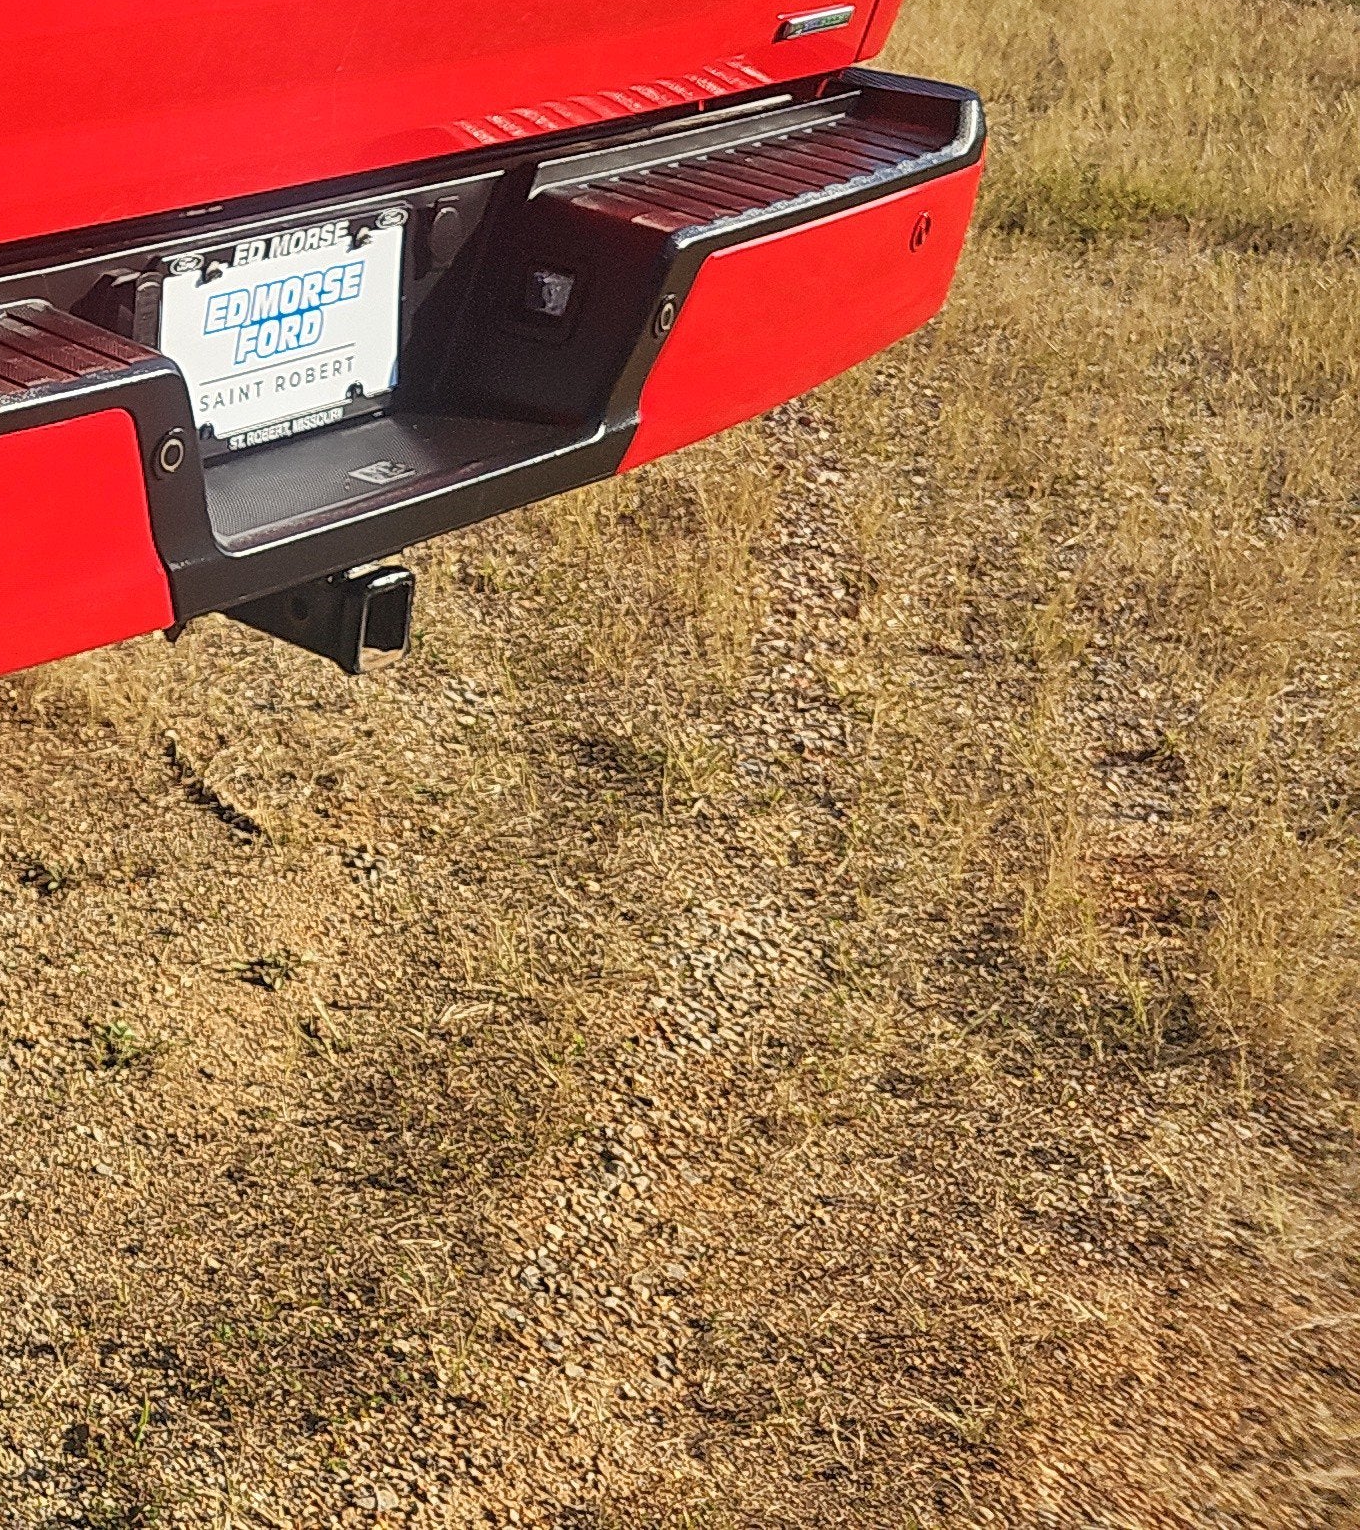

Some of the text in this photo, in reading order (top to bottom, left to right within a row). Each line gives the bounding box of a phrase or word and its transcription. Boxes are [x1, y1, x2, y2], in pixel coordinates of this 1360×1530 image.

[233, 242, 268, 269] ED
[269, 219, 351, 258] MORSE
[203, 260, 365, 335] ED MORSE
[234, 308, 324, 365] FORD
[199, 356, 356, 412] SAINT ROBERT
